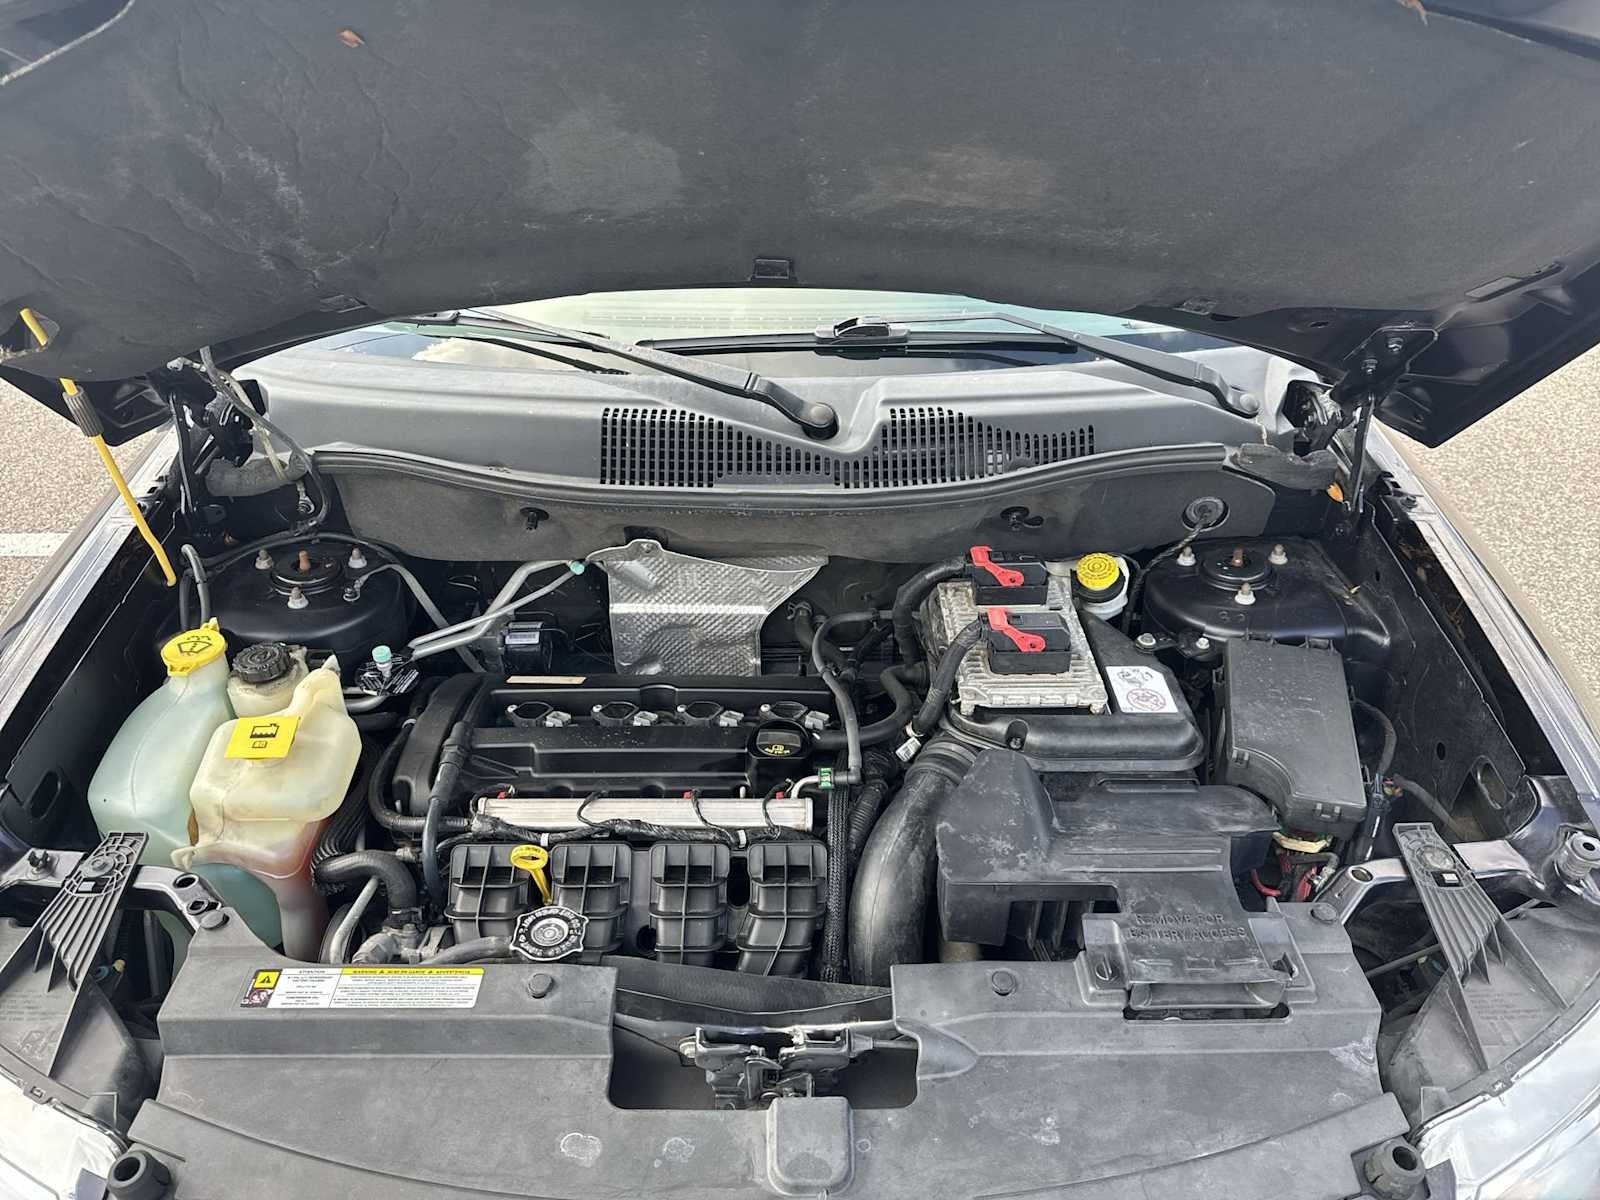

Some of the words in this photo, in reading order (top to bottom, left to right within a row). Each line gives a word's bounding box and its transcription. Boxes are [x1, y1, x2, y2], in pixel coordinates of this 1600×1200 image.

[1136, 914, 1191, 925] REMOVE
[1198, 913, 1225, 924] FOR
[1129, 926, 1188, 940] BATTERY
[1193, 926, 1247, 939] ACCESS
